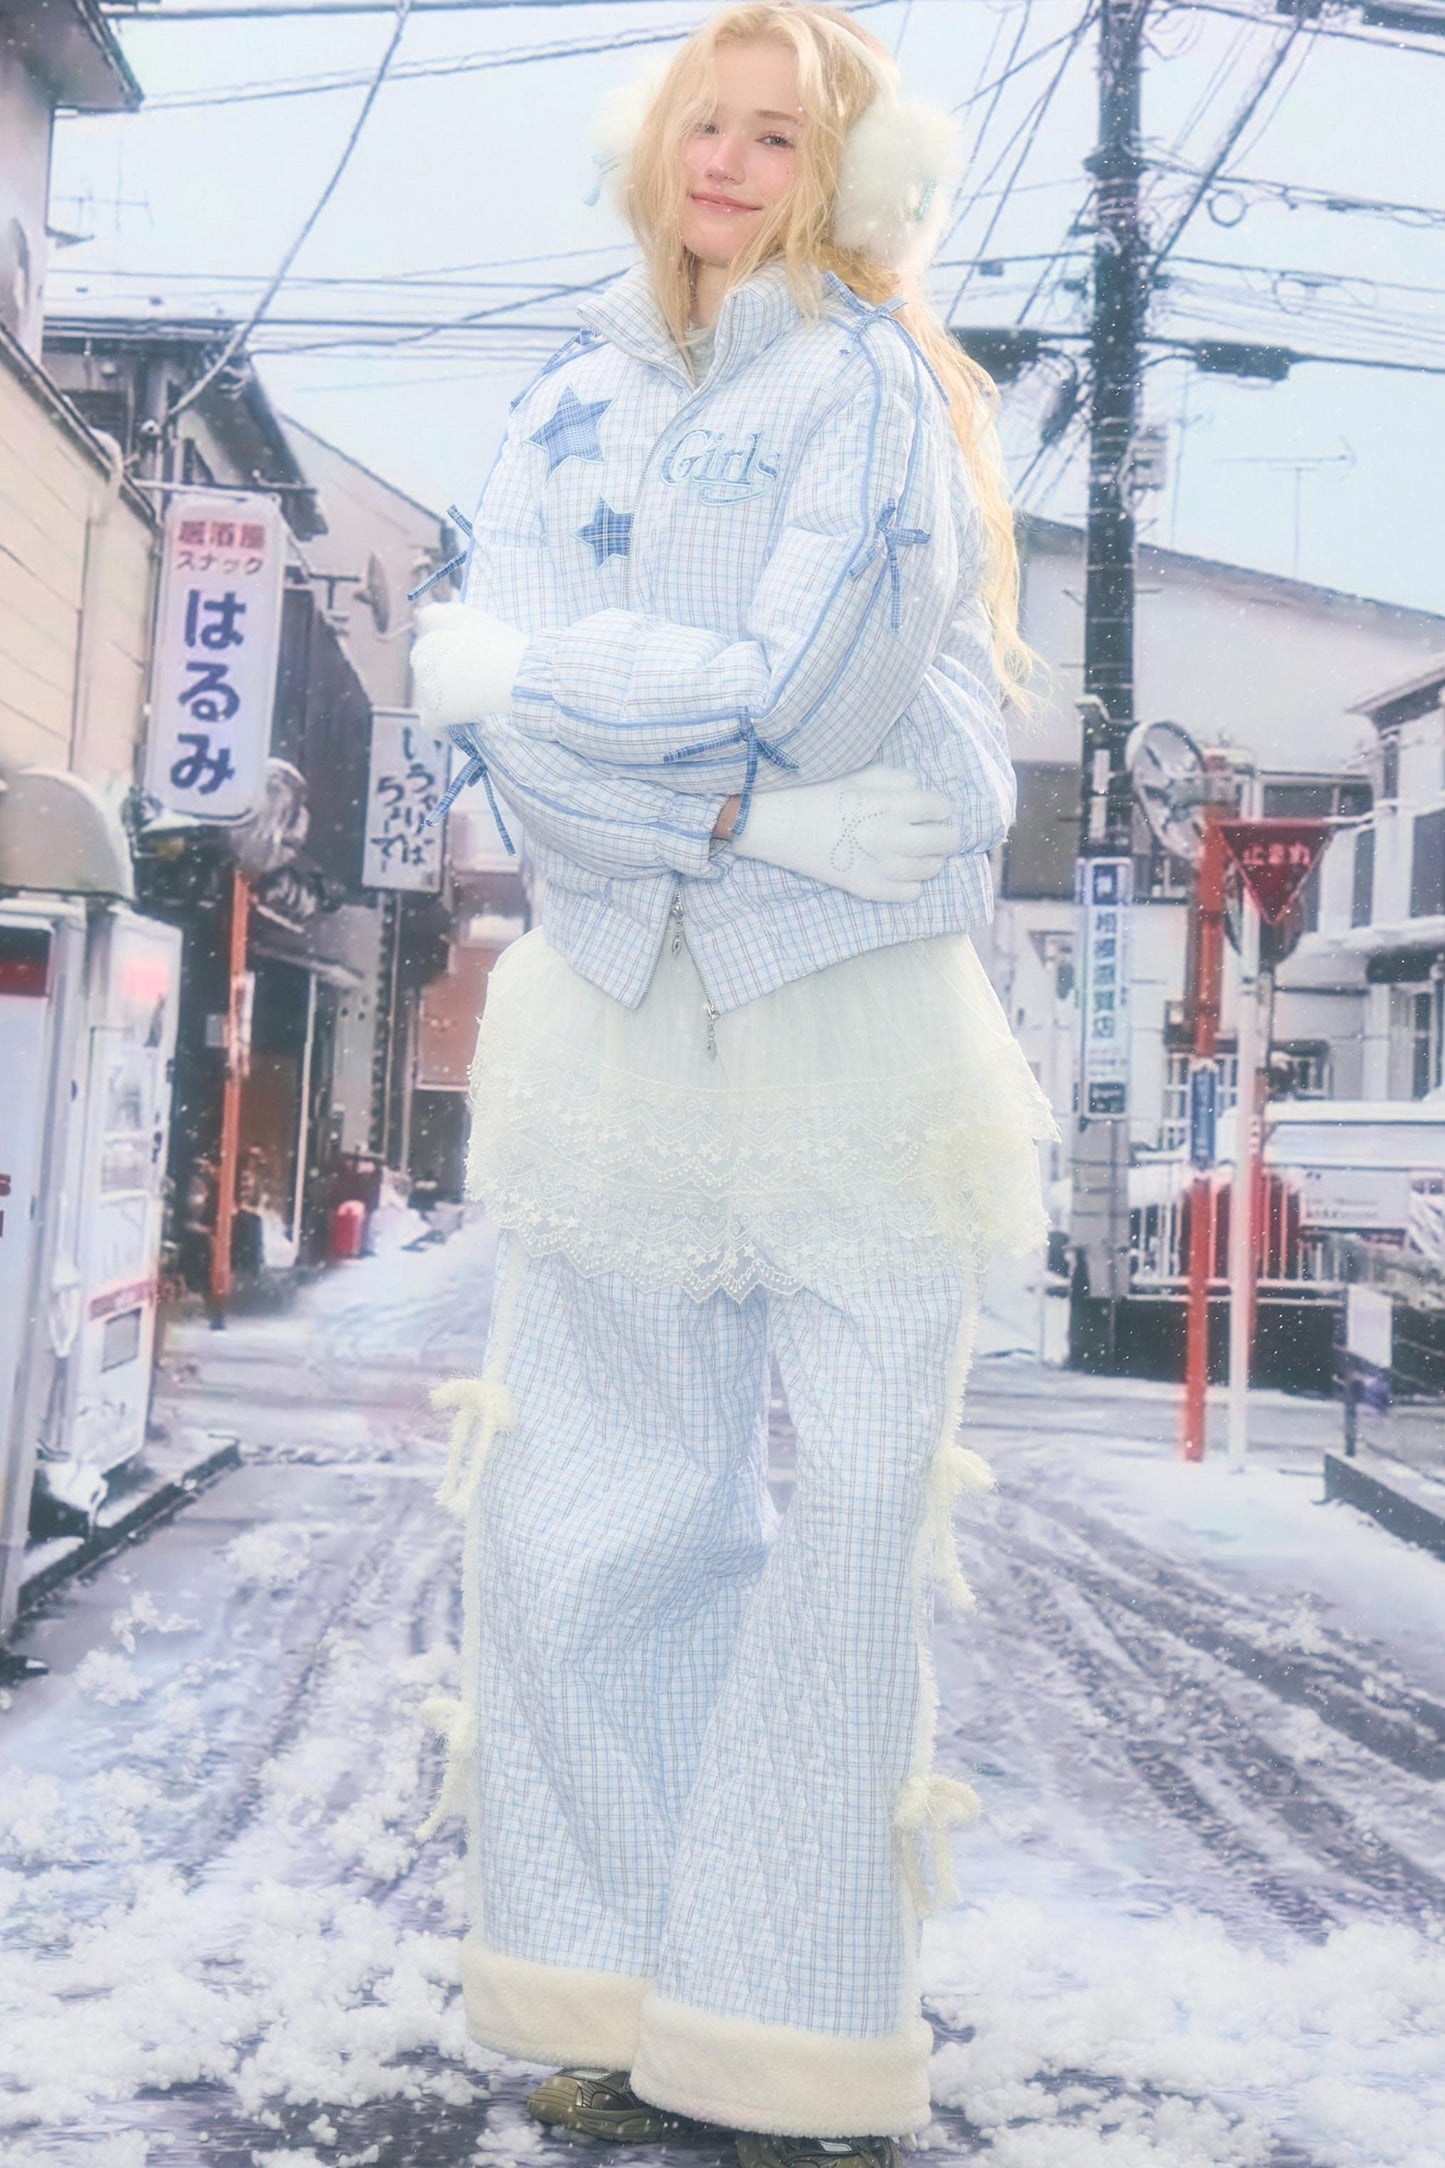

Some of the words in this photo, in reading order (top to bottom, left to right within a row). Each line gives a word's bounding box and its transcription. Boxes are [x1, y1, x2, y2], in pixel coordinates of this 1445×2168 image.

[659, 427, 781, 506] Girls
[176, 550, 263, 575] スナック
[169, 589, 247, 795] はるみ
